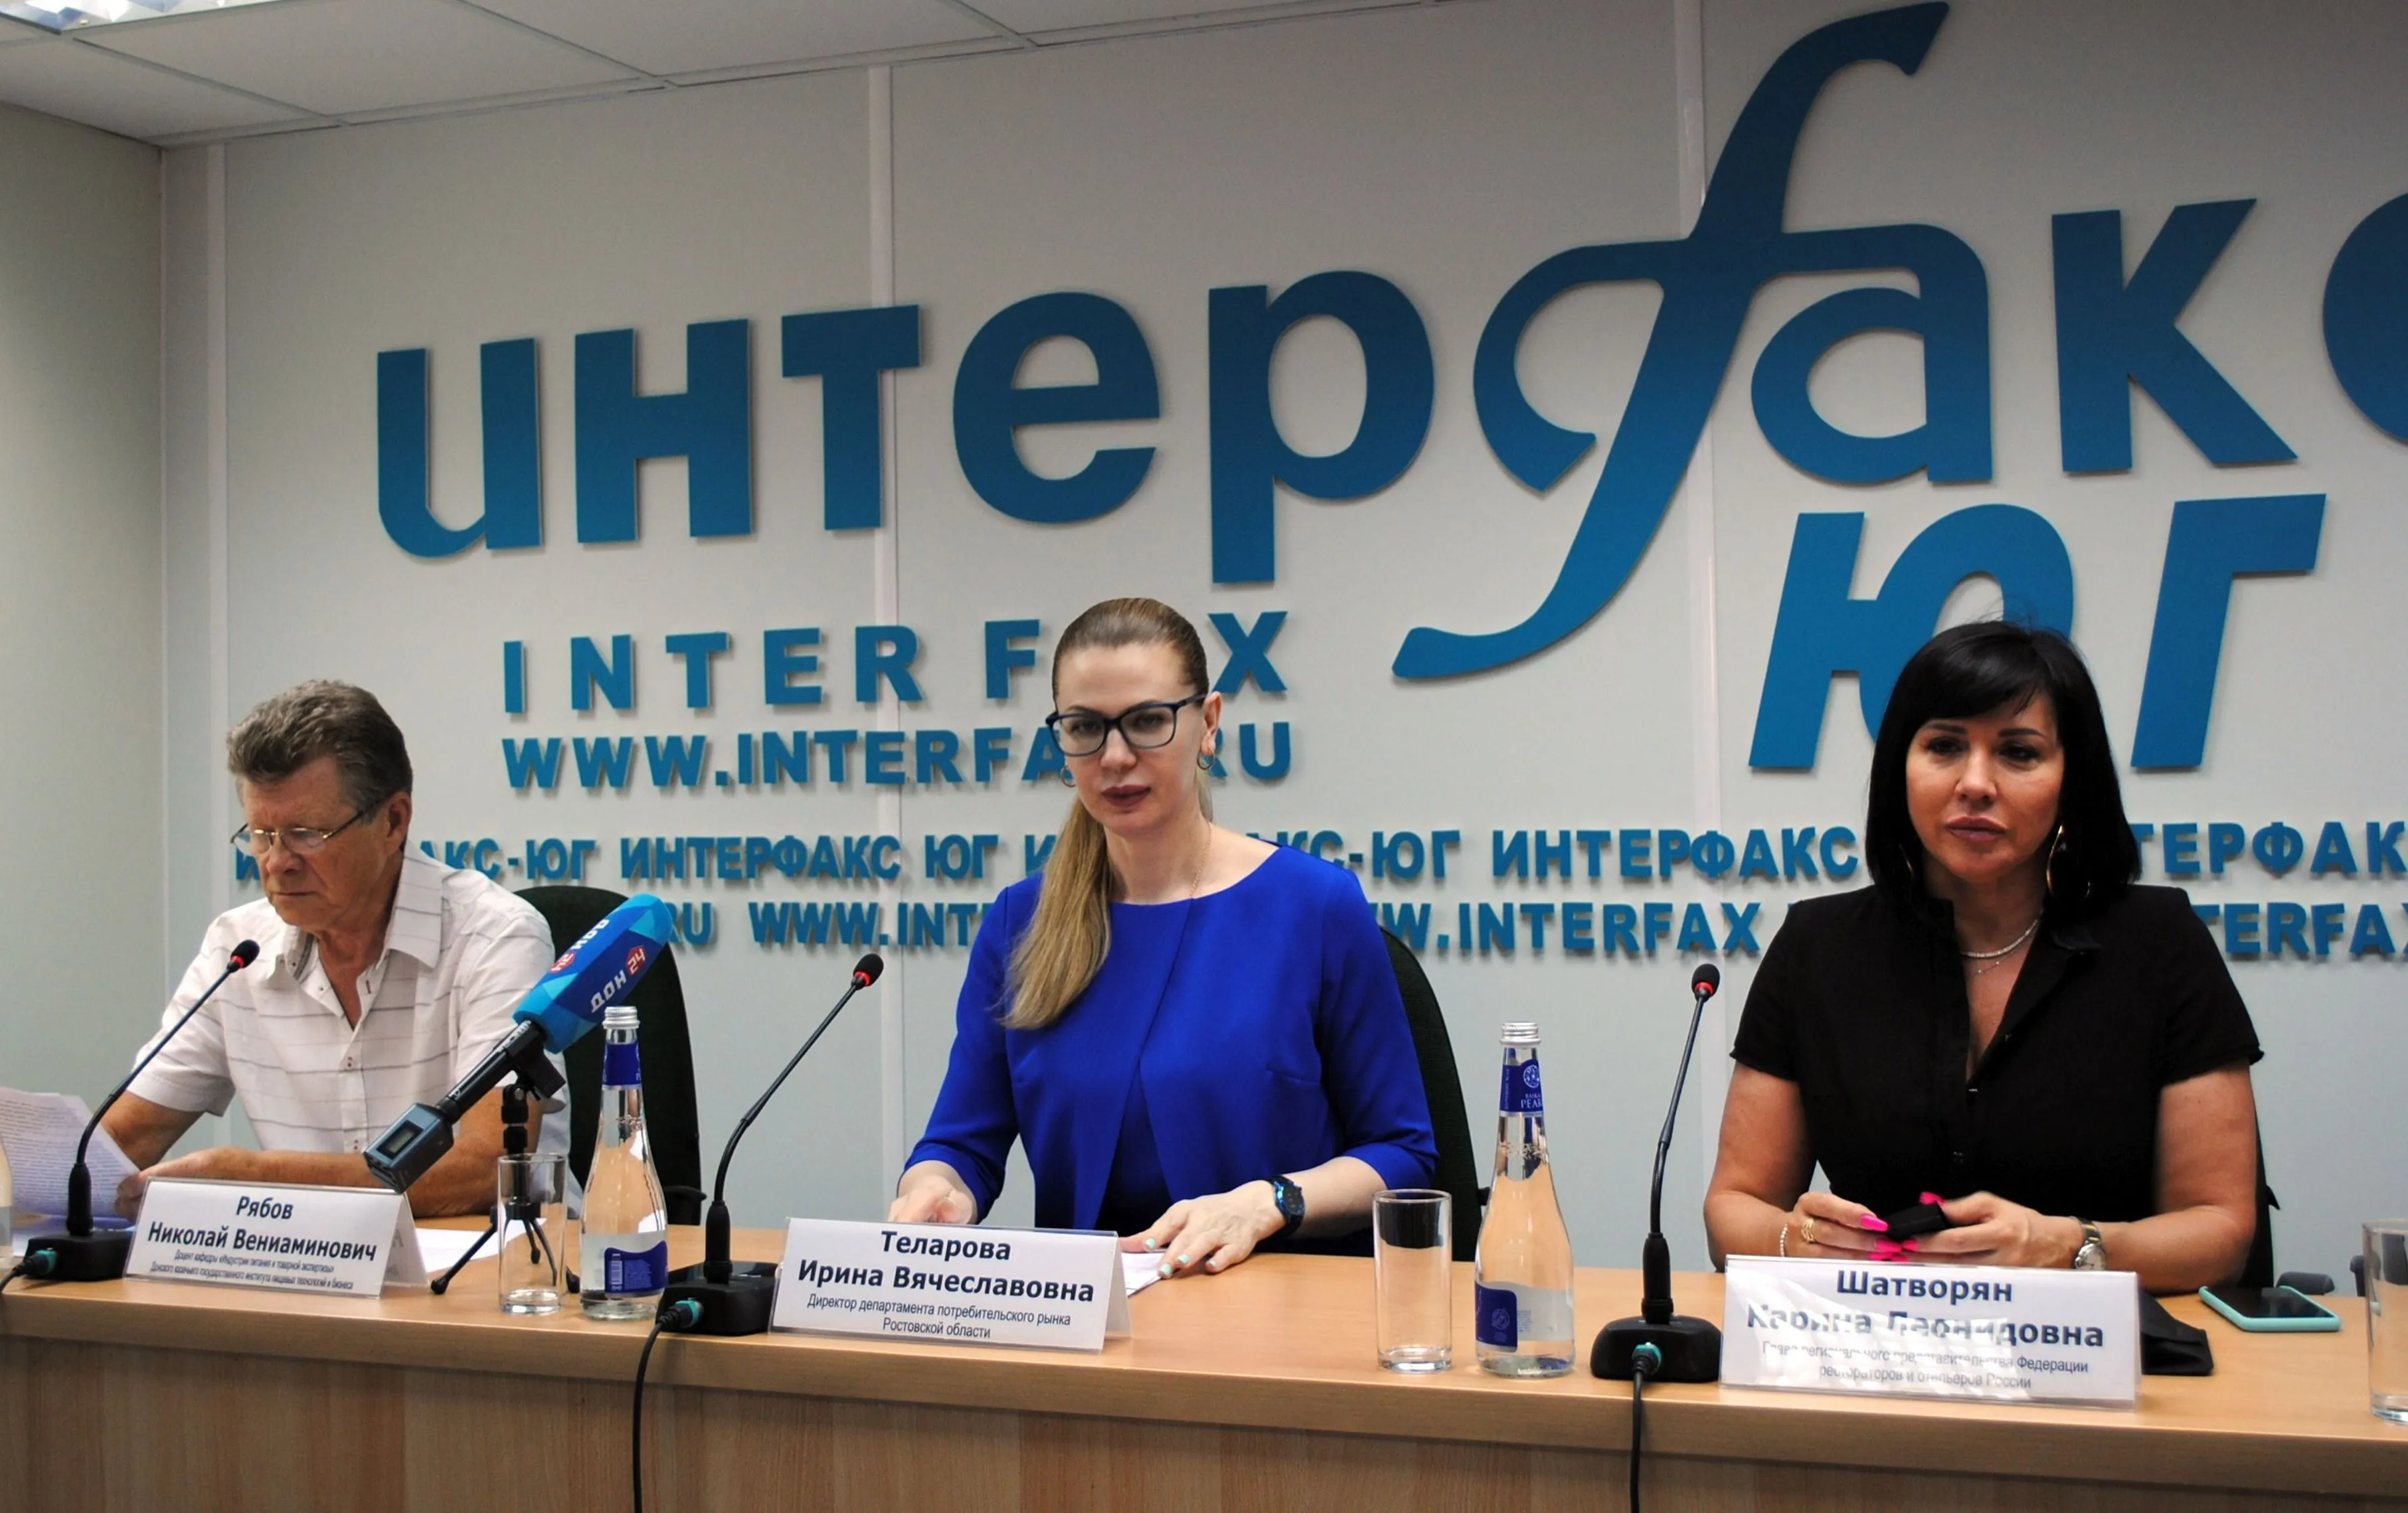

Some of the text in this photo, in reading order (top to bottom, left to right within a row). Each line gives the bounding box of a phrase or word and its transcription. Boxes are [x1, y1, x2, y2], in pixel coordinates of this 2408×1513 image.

[503, 611, 1288, 714] INTERFX
[501, 722, 1290, 788] WWW.INTERFAU
[621, 835, 900, 880] ИНТЕРФАКС
[925, 834, 998, 880] ЮГ
[1492, 826, 1859, 878] ИНТЕРФАКС
[748, 902, 993, 946] WWW.INT
[1369, 902, 1761, 952] W.INTERFAX
[590, 948, 646, 1013] ДОН 24
[236, 1196, 294, 1220] Рябов
[147, 1222, 228, 1247] Николай
[233, 1229, 377, 1261] Вениаминович
[881, 1231, 1011, 1262] Теларова
[798, 1259, 1094, 1302] Ирина Вячеславовна
[1836, 1269, 2012, 1305] Шатворян
[807, 1293, 1071, 1326] Директор департамента потребительского рынка
[883, 1316, 991, 1338] Ростовской области
[2017, 1355, 2089, 1374] Федерации
